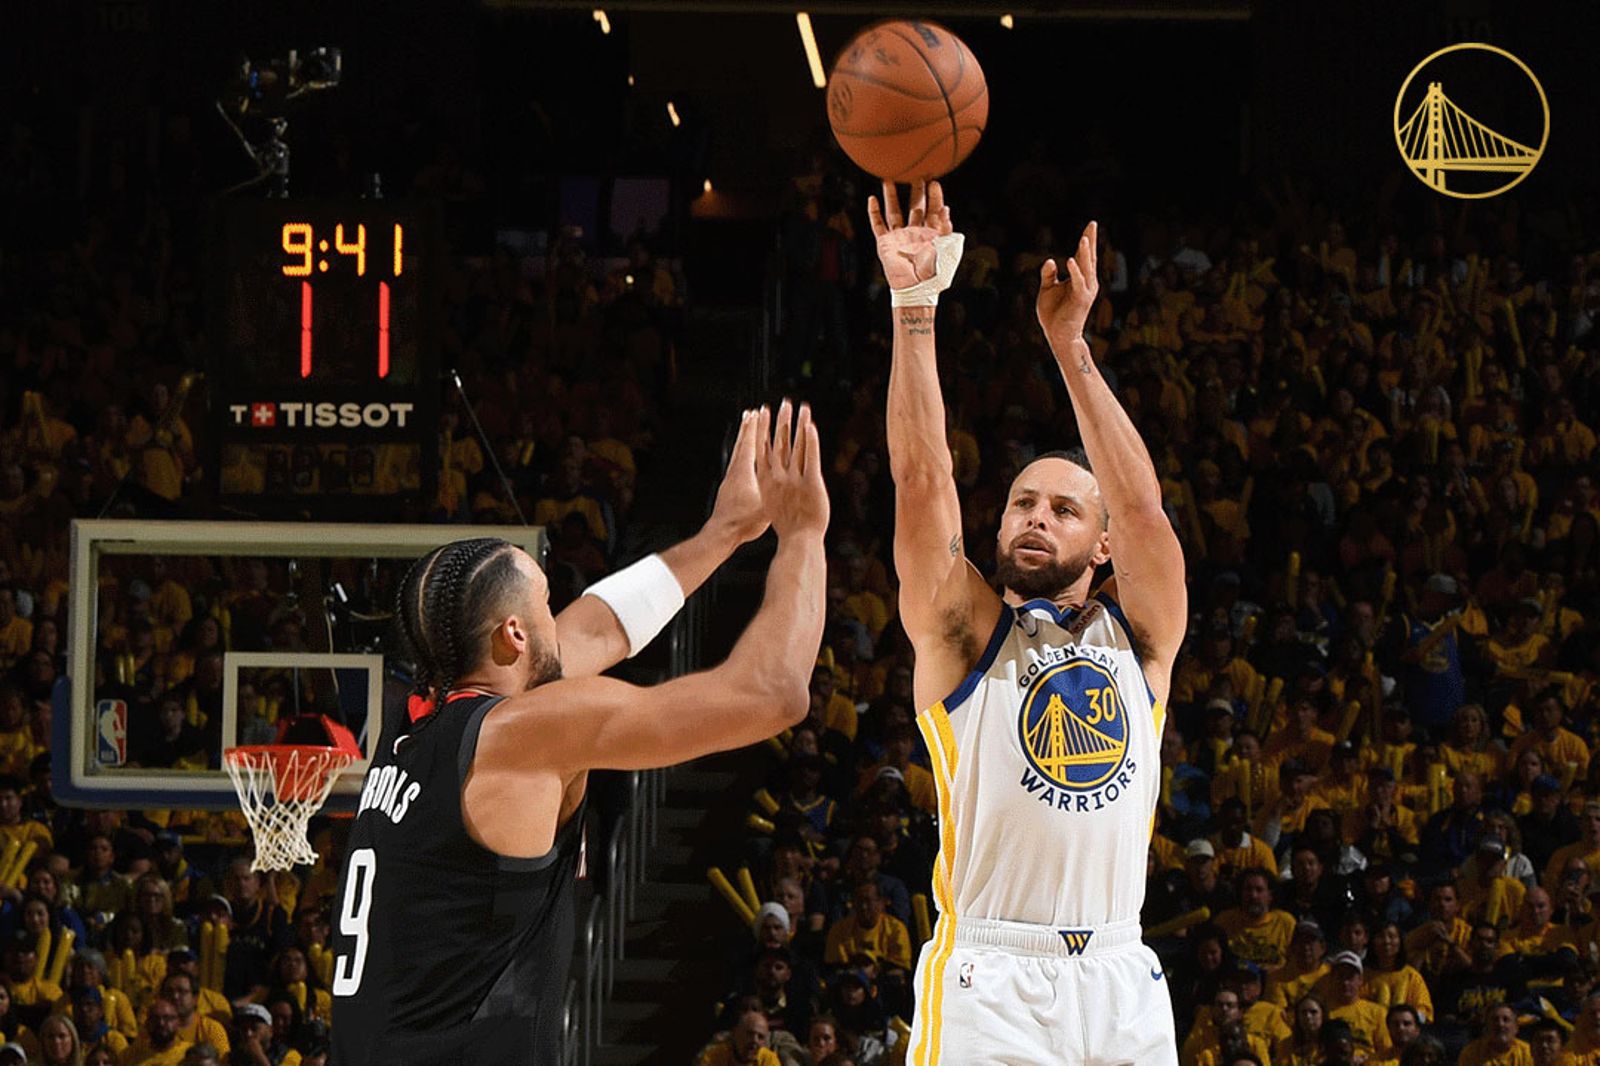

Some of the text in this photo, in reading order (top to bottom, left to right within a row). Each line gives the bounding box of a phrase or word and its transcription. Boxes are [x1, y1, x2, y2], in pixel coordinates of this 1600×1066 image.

[282, 223, 403, 277] 9:41
[280, 402, 413, 427] TISSOT
[1019, 646, 1118, 688] GOLDEN STATE
[1085, 687, 1117, 725] 30
[1019, 757, 1136, 812] WARRIORS
[333, 848, 376, 996] 9
